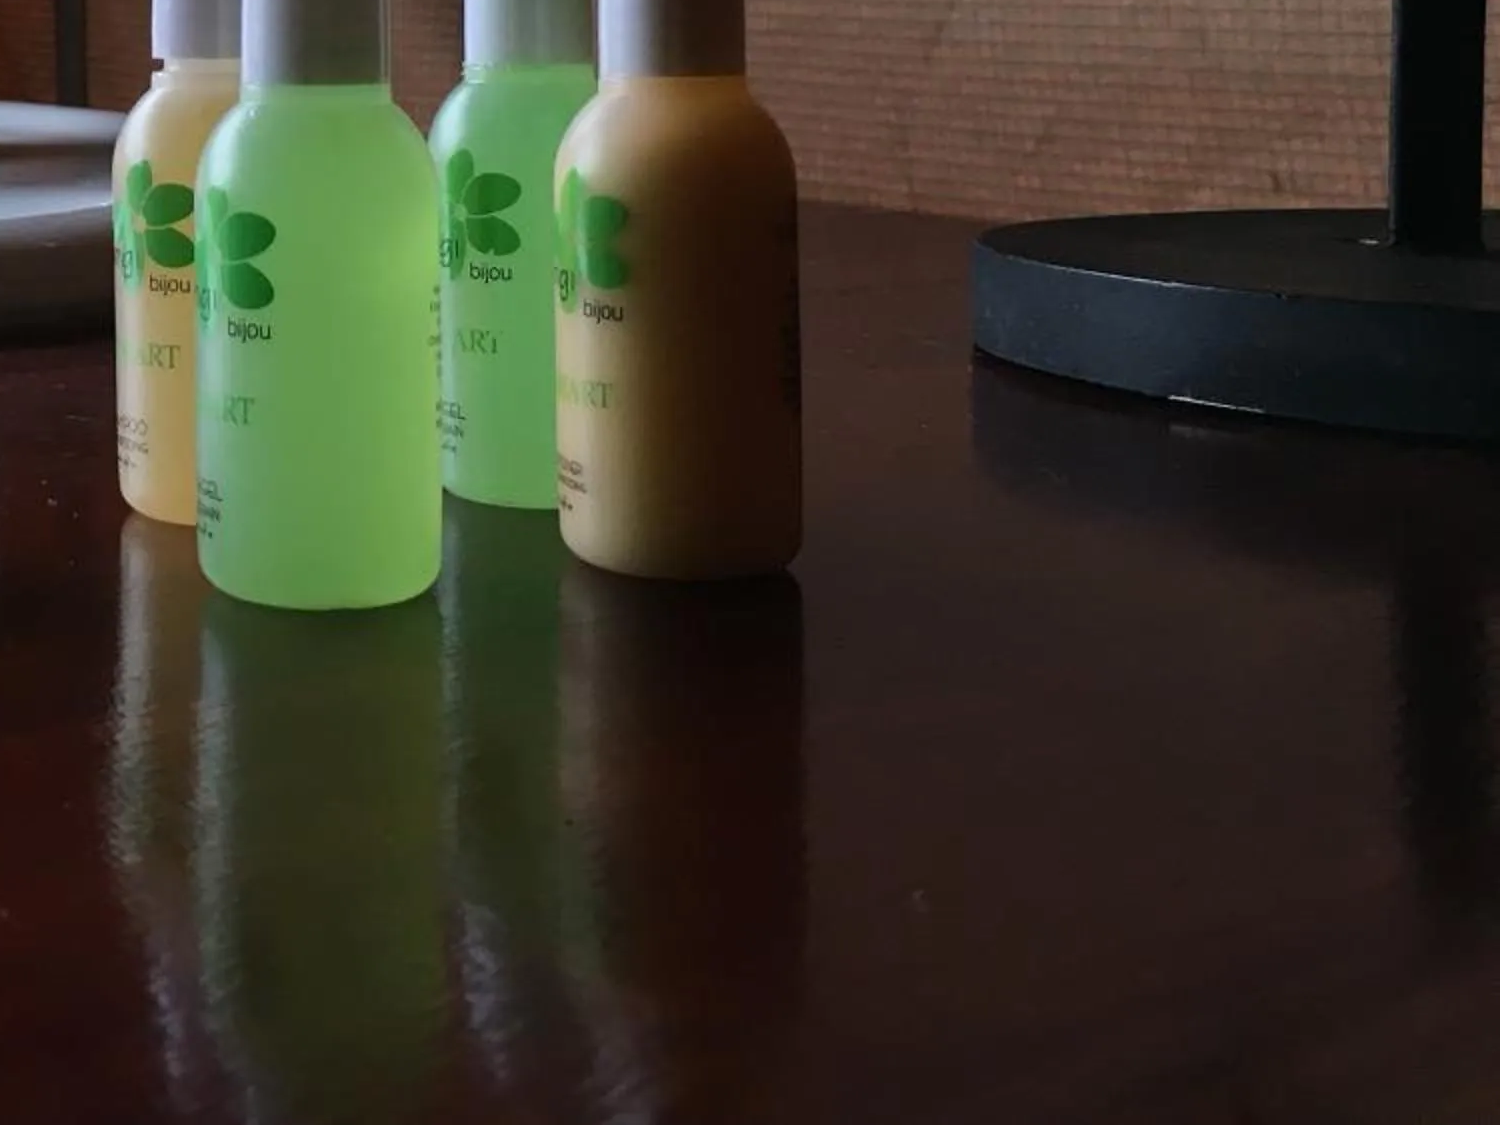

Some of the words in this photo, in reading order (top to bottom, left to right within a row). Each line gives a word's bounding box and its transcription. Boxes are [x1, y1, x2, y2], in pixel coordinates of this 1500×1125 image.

[149, 272, 191, 296] bijou
[469, 262, 513, 284] bijou
[583, 298, 624, 324] bijou
[227, 316, 271, 344] bijou
